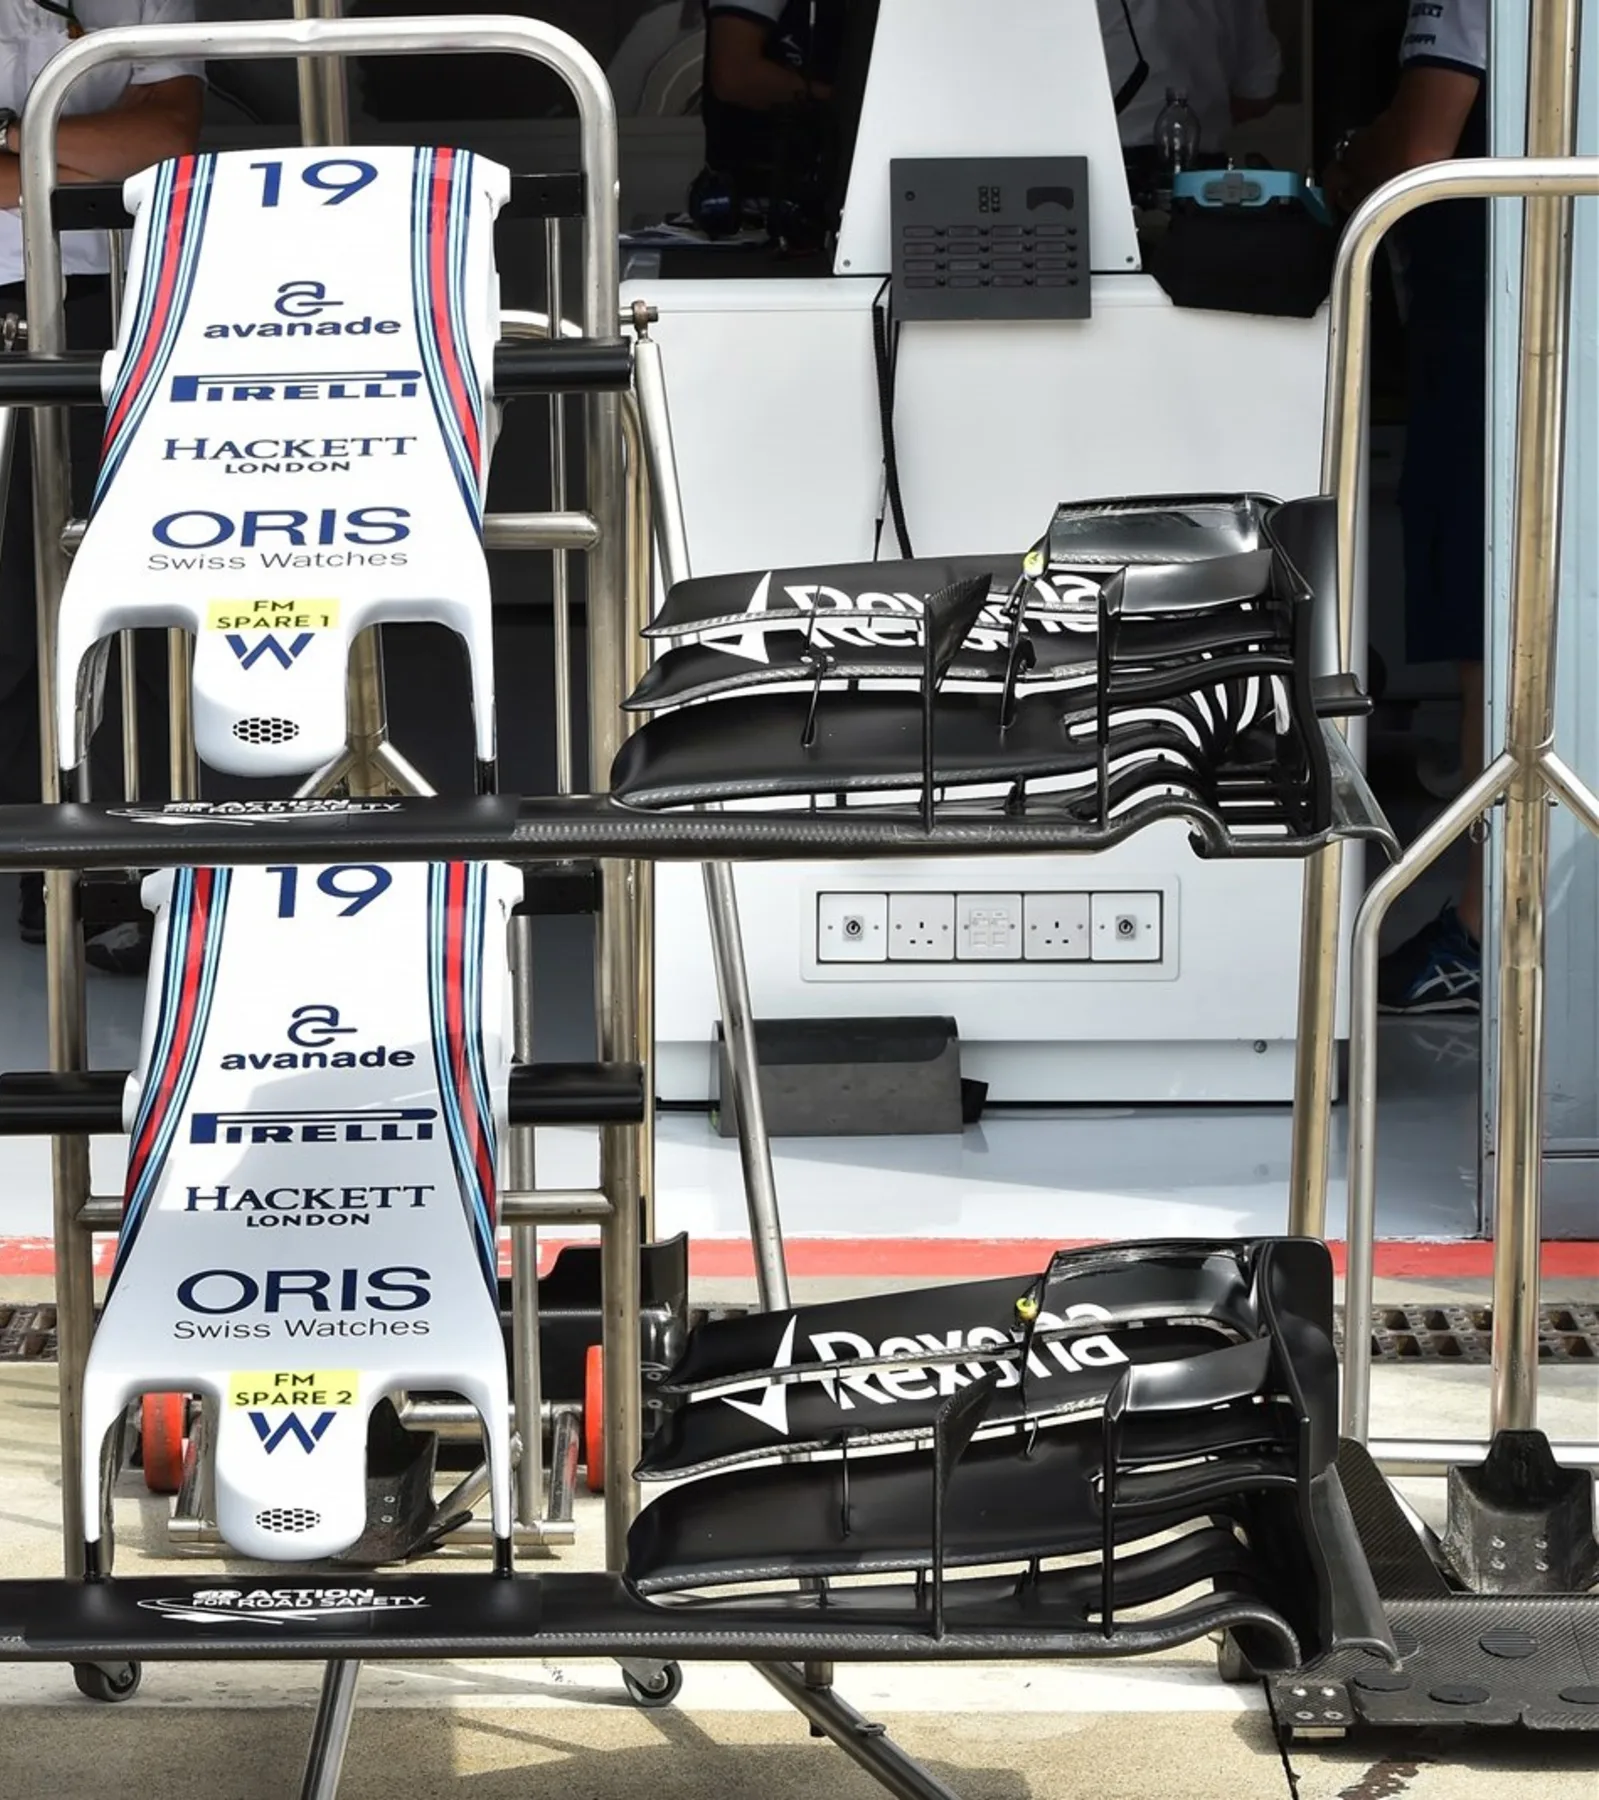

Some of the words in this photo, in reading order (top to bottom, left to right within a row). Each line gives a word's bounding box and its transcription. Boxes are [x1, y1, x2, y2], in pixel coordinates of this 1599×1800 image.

[250, 160, 378, 207] 19
[204, 317, 401, 338] avanade
[170, 370, 422, 402] PIRELLI
[162, 437, 417, 460] HACKETT
[225, 461, 349, 473] LONDON
[152, 507, 410, 549] ORIS
[148, 554, 246, 571] Swiss
[260, 551, 408, 569] Watches
[253, 601, 295, 612] FM
[217, 615, 310, 628] SPARE
[322, 615, 329, 627] 1
[266, 865, 392, 918] 19
[220, 1046, 416, 1069] avanade
[190, 1108, 438, 1144] PIRELLI
[184, 1185, 435, 1211] HACKETT
[247, 1213, 370, 1227] LONDON
[177, 1266, 431, 1314] ORIS
[174, 1320, 271, 1339] Swiss
[284, 1318, 430, 1338] Watches
[809, 1304, 1129, 1410] Rexona
[274, 1374, 315, 1386] FM
[235, 1391, 327, 1406] SPARE
[336, 1391, 352, 1405] 2
[238, 1598, 314, 1608] ROAD
[320, 1597, 426, 1607] SAFETY
[247, 1588, 374, 1600] ACTION
